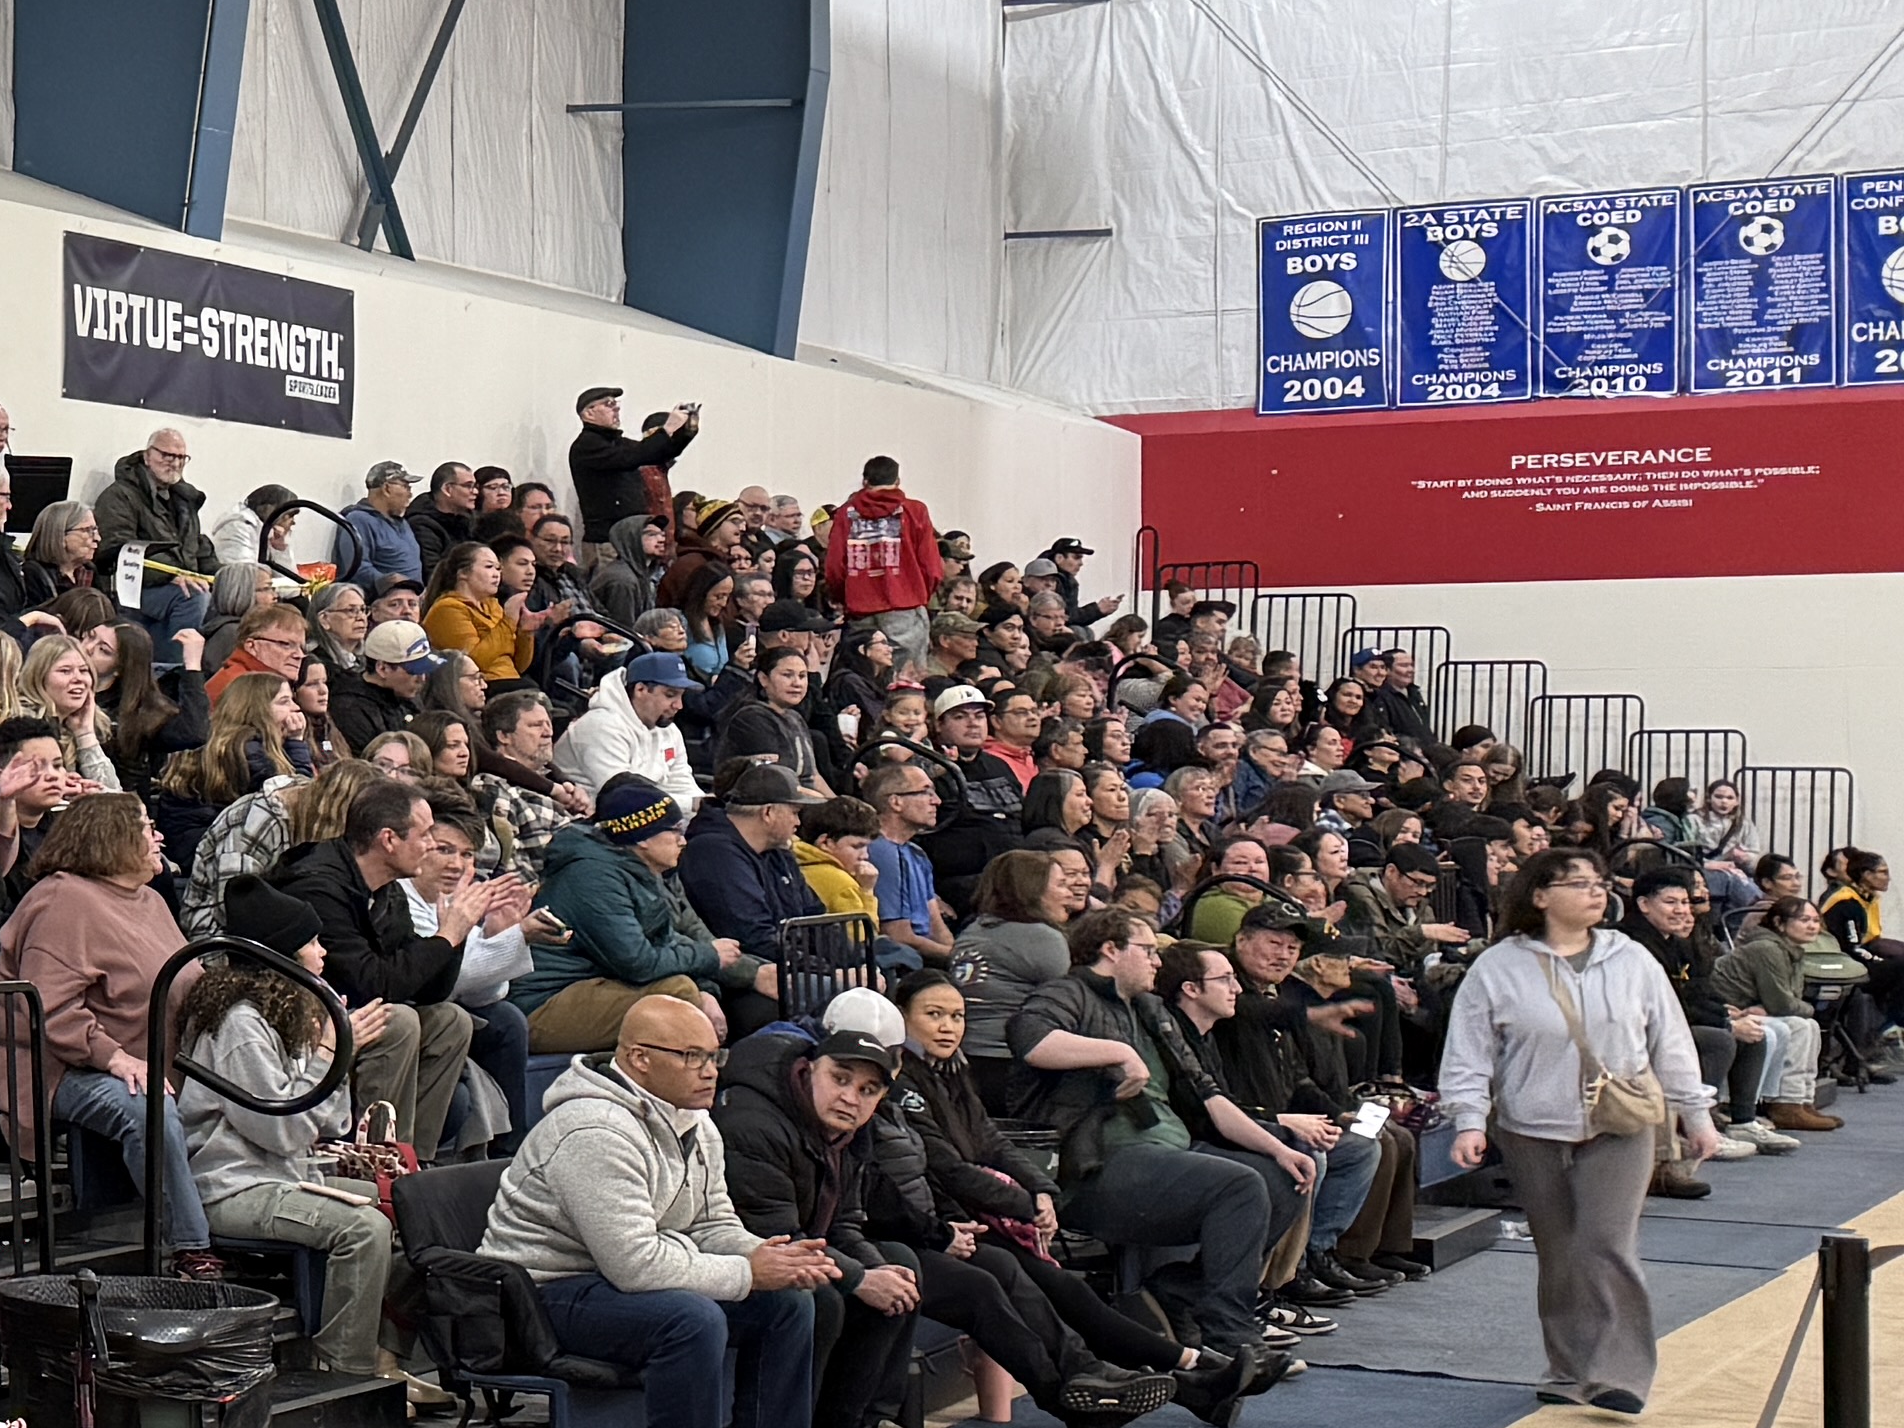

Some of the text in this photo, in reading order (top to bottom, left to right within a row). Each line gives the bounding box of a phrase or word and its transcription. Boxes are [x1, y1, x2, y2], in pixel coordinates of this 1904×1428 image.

[1615, 194, 1674, 209] STATE
[1697, 183, 1829, 203] ACSAA STATE
[1728, 198, 1796, 215] COED
[1403, 206, 1524, 228] 2A STATE
[1576, 210, 1642, 226] COED
[1283, 221, 1347, 236] REGION
[1426, 222, 1499, 242] BOYS
[1275, 235, 1350, 252] DISTRICT
[1287, 253, 1357, 275] BOYS
[1266, 348, 1380, 373] CHAMPIONS
[1707, 354, 1820, 371] CHAMPIONS
[1411, 369, 1517, 386] CHAMPIONS
[1554, 363, 1663, 379] CHAMPIONS
[1725, 367, 1801, 386] 2011
[1283, 376, 1365, 403] 2004
[1427, 382, 1501, 401] 2004
[1511, 447, 1711, 470] PERSEVERANCE
[1458, 479, 1472, 488] BY
[1645, 471, 1679, 480] THEN
[1682, 471, 1699, 479] DO
[1462, 490, 1489, 499] AND
[1490, 488, 1553, 498] SUDDENLY
[1555, 486, 1580, 496] YOU
[1583, 485, 1608, 494] ARE
[1652, 482, 1677, 492] THE
